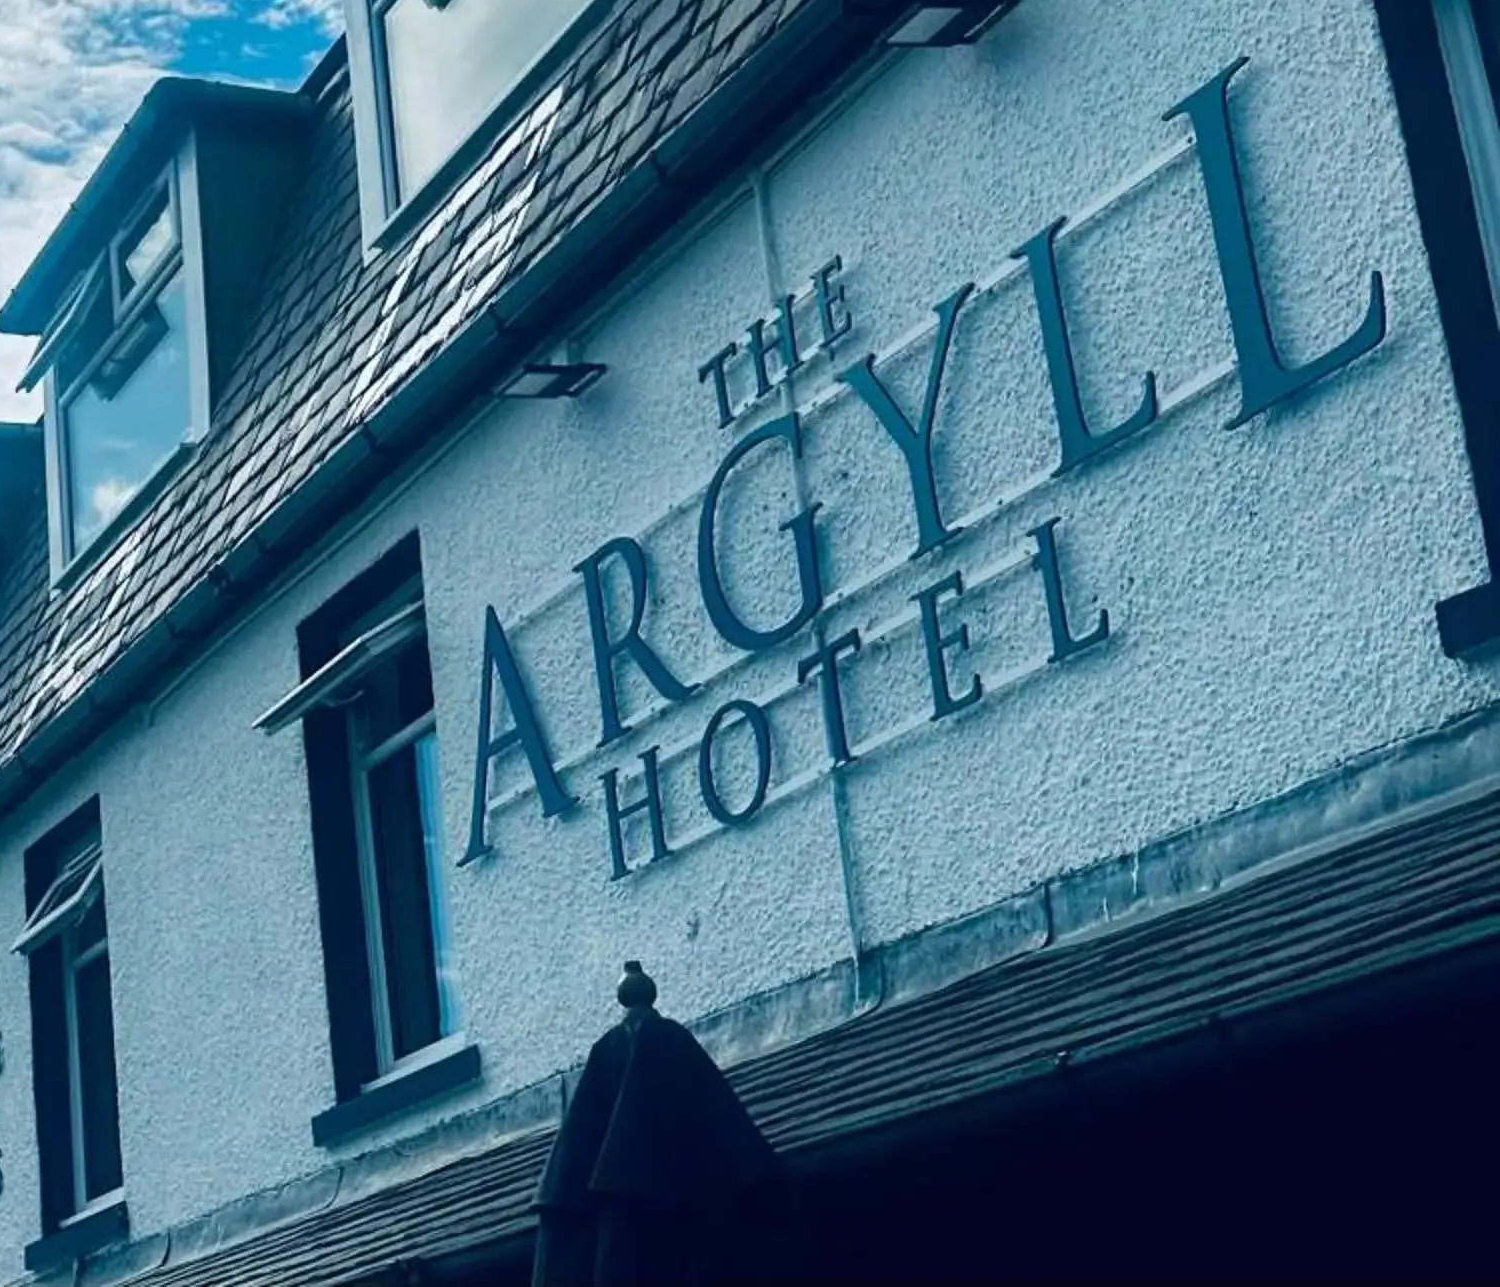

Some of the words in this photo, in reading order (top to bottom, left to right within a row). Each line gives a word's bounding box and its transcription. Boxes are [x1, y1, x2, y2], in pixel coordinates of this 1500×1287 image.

[456, 56, 1387, 868] ARGYLL
[699, 256, 853, 429] THE
[598, 517, 1109, 881] HOTEL
